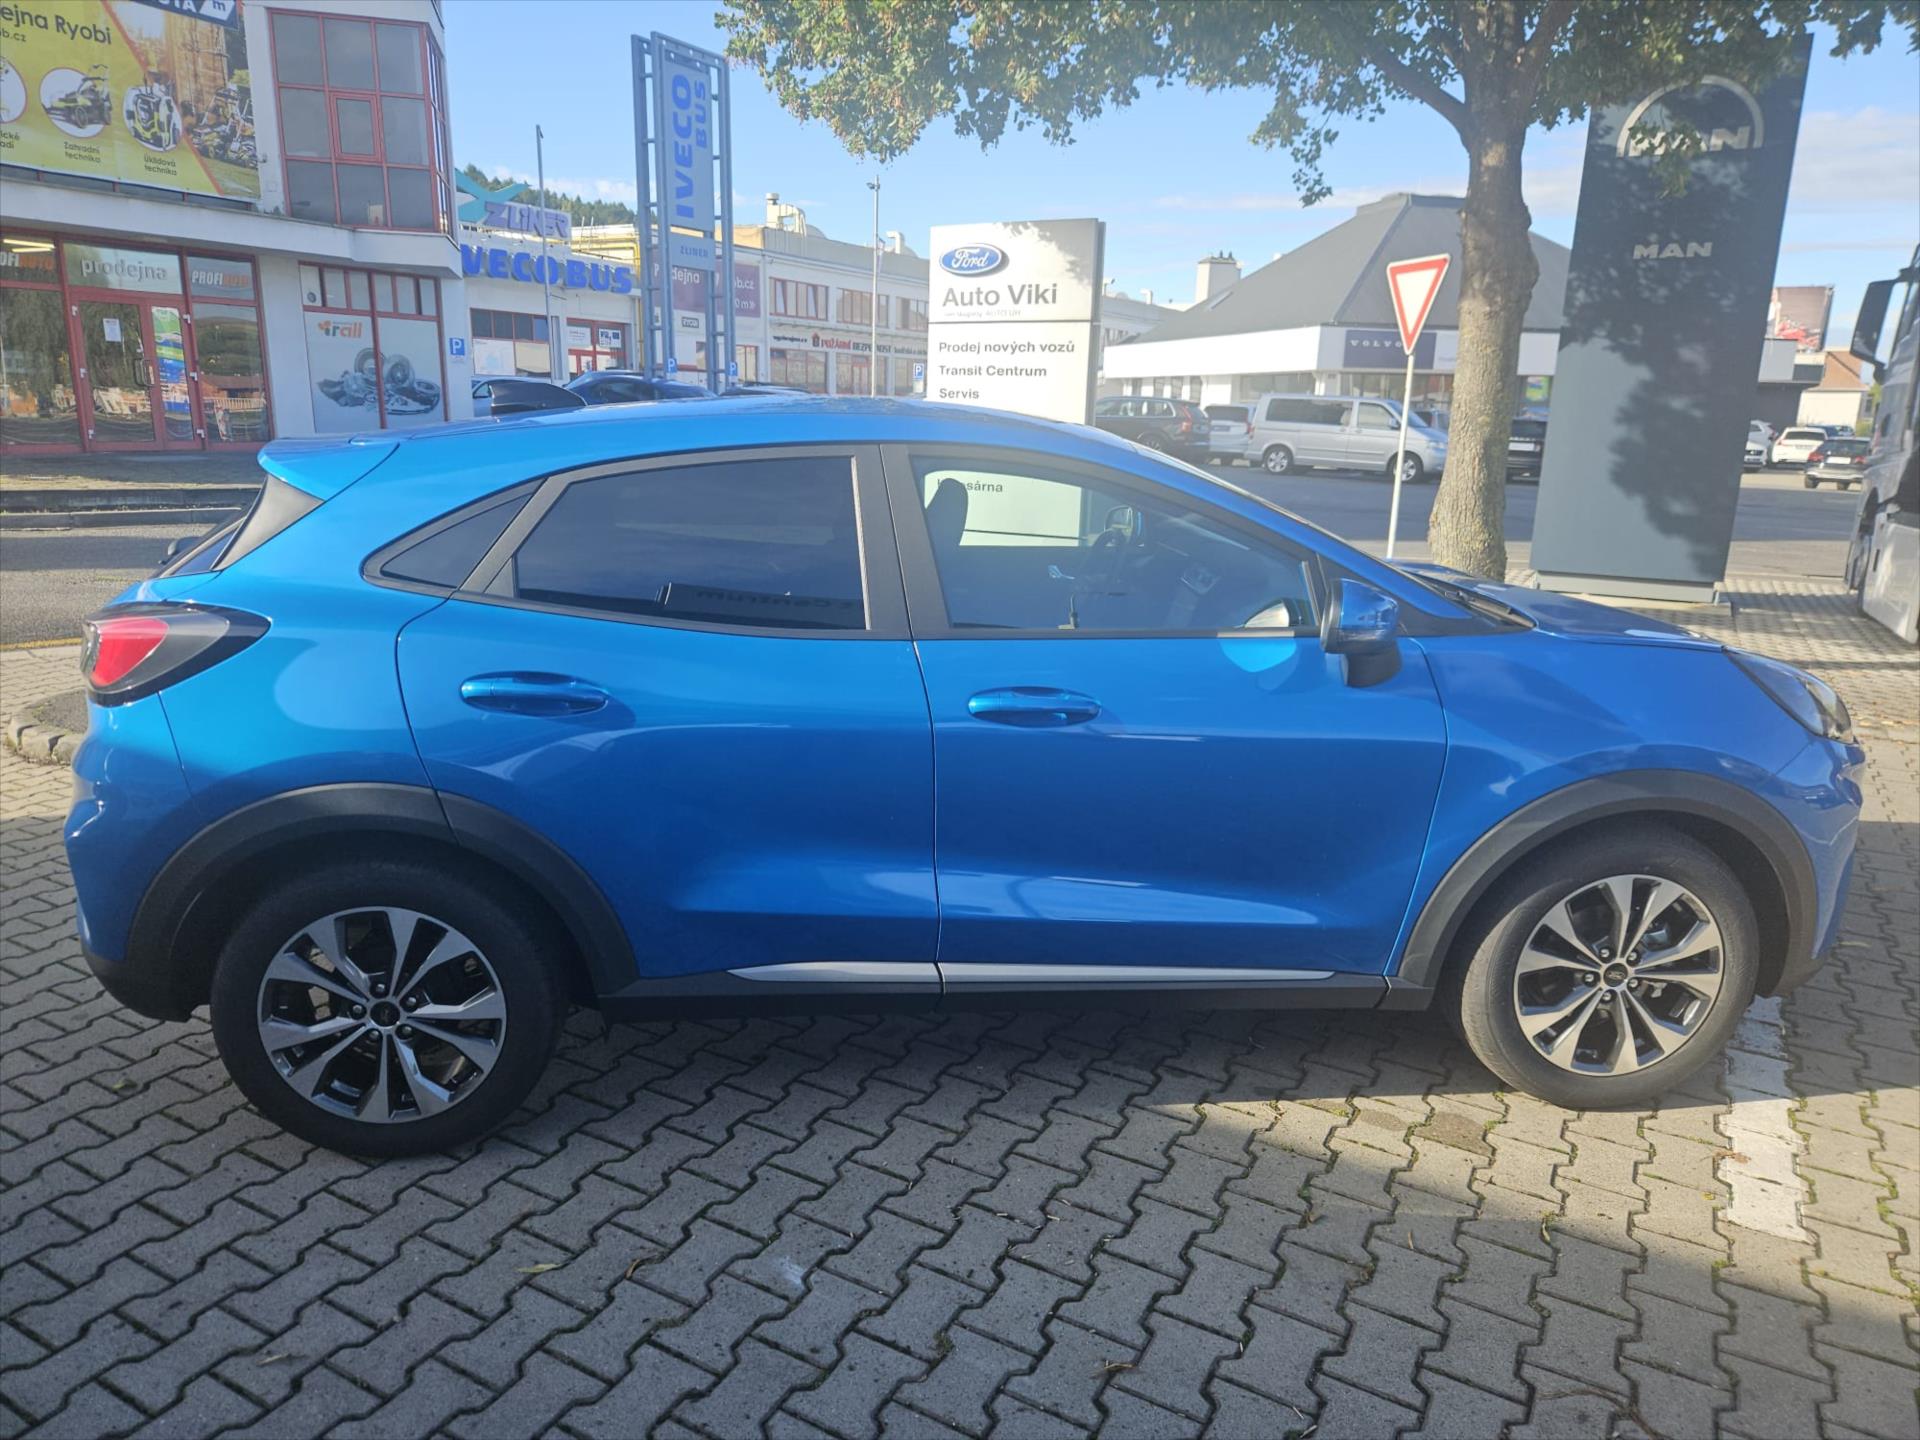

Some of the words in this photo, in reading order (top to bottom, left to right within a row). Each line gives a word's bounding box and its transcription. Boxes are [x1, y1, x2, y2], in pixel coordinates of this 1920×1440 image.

[0, 4, 48, 30] ejna
[55, 14, 111, 44] Ryobi
[0, 28, 26, 42] b.cz
[694, 79, 708, 149] BUS
[671, 74, 694, 219] IVECO
[951, 248, 988, 269] Ford
[1633, 242, 1713, 259] MAN
[80, 256, 168, 282] prodejna
[460, 244, 559, 285] VECO
[942, 287, 1000, 307] Auto
[1008, 283, 1057, 305] Viki
[452, 339, 462, 354] P
[939, 342, 981, 355] Prodej
[984, 340, 1035, 355] nových
[1040, 340, 1075, 353] vozů
[1350, 339, 1402, 348] VOLVO
[668, 358, 676, 372] P
[730, 361, 737, 375] P
[939, 365, 982, 376] Transit
[986, 364, 1047, 377] Centrum
[939, 388, 980, 399] Servis
